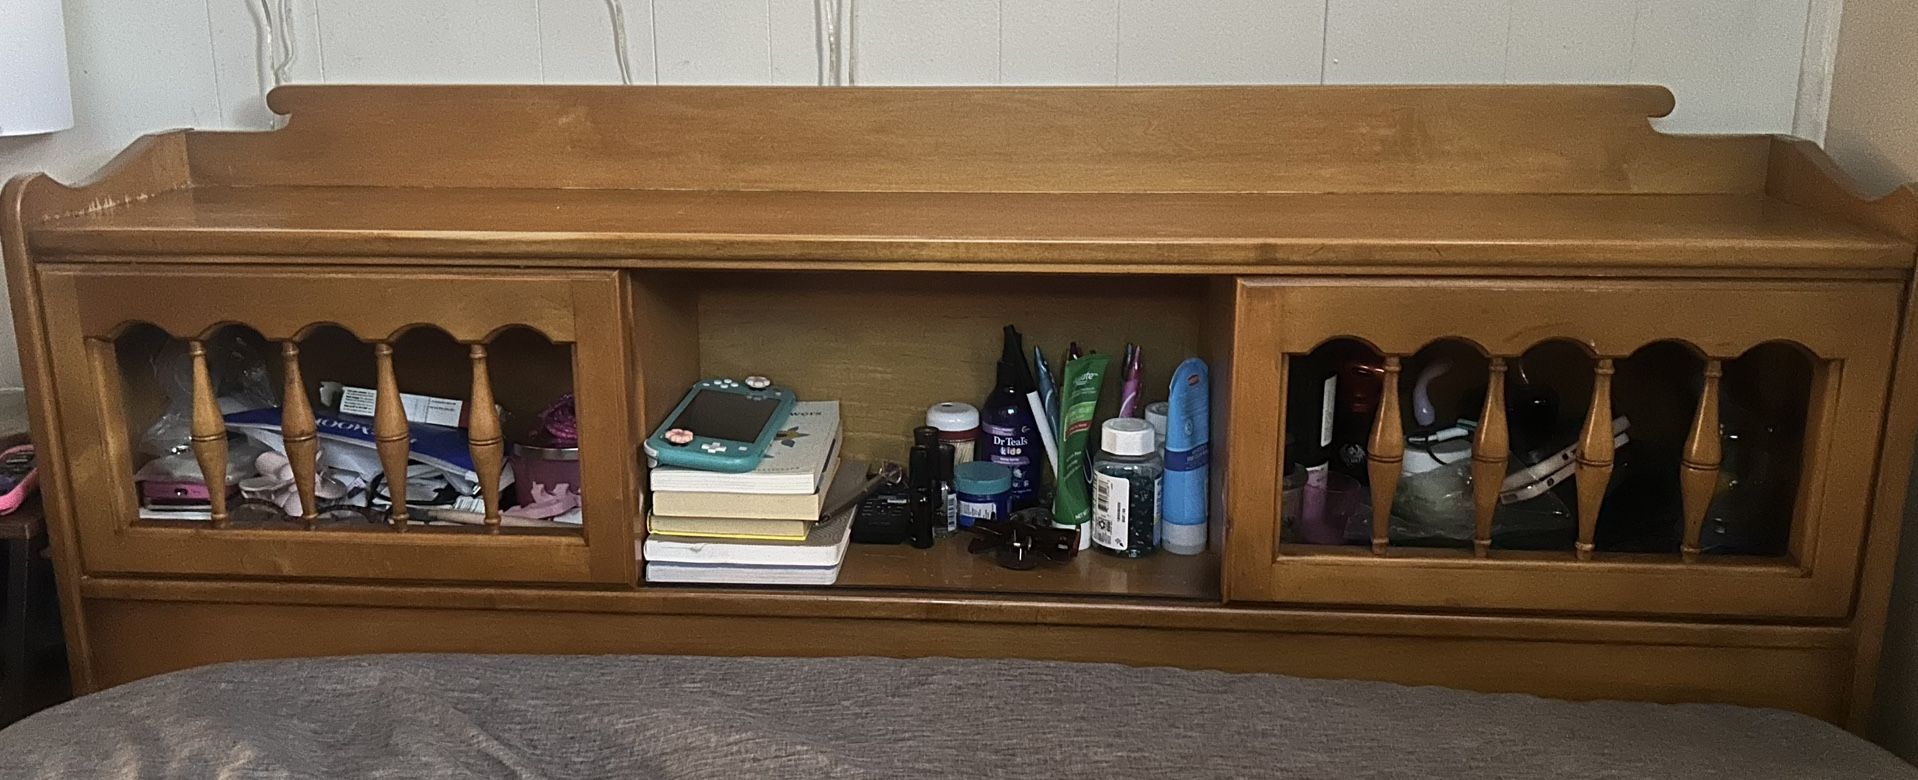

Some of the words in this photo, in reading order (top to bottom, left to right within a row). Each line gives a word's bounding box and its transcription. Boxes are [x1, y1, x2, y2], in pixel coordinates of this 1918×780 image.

[993, 436, 1006, 446] Dr
[1005, 436, 1028, 446] Teal's
[1000, 447, 1022, 456] kids
